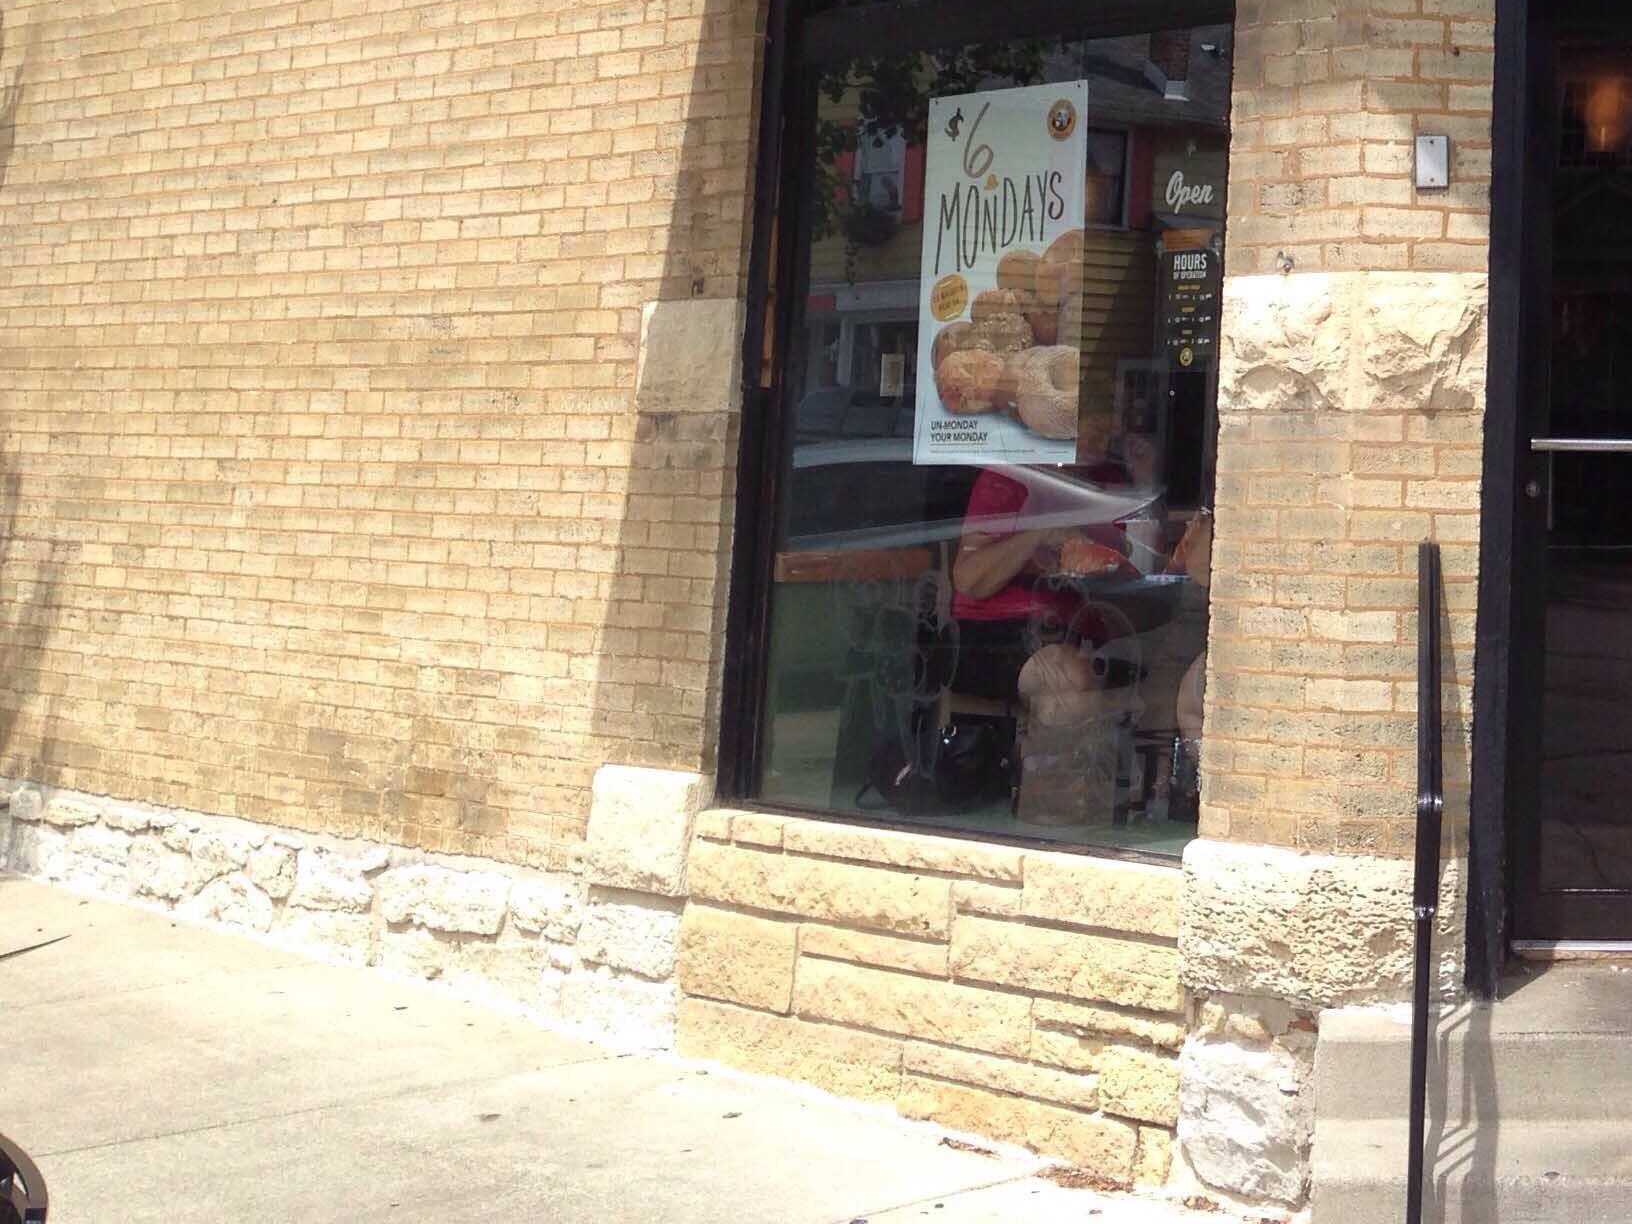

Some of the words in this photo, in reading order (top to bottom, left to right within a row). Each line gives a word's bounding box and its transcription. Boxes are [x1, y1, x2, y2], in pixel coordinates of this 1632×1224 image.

[1165, 170, 1215, 214] Open
[934, 170, 1065, 275] MONDAYS
[1173, 253, 1208, 271] HOURS
[930, 419, 979, 431] UN-MONDAY
[930, 432, 951, 442] YOUR
[953, 431, 988, 442] MONDAY
